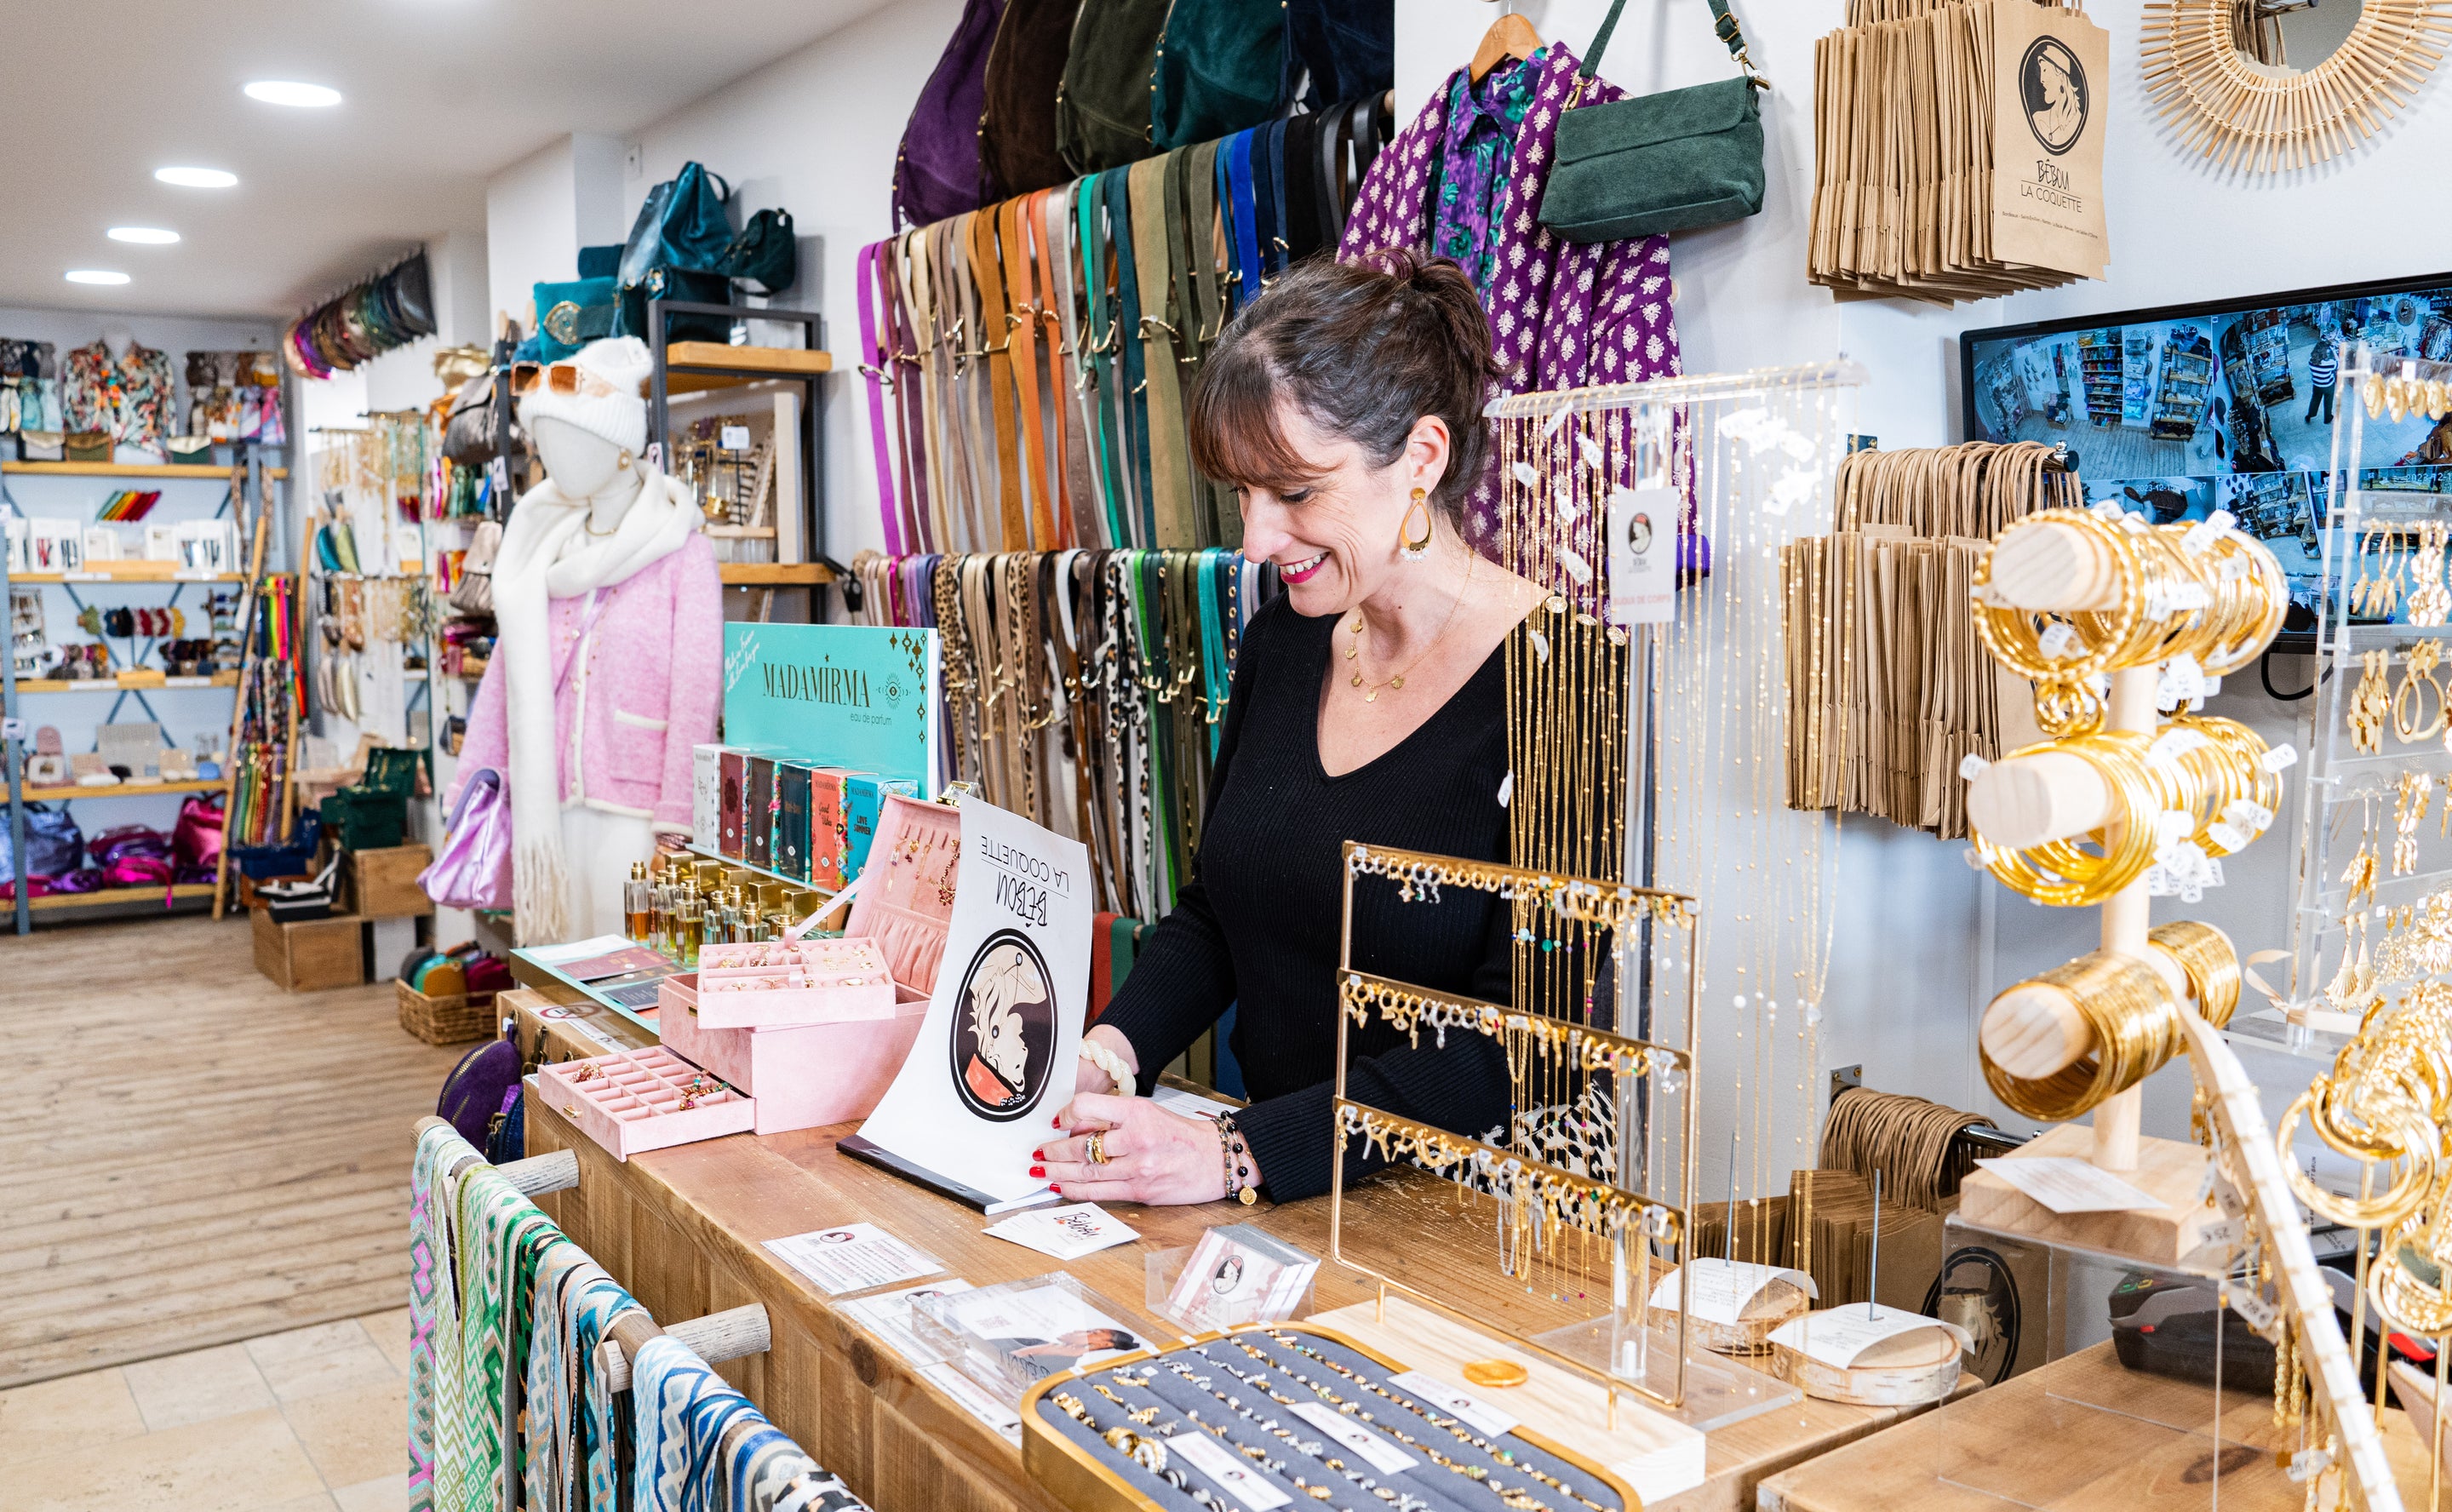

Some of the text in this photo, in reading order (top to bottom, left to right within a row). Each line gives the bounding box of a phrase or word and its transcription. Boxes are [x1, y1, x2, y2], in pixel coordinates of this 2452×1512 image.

[2020, 183, 2082, 213] LA COQUETTE
[850, 713, 892, 726] eau de parfum
[856, 815, 868, 826] LOVE
[854, 823, 872, 836] SUMMER
[981, 835, 1069, 893] LA COQUETTE
